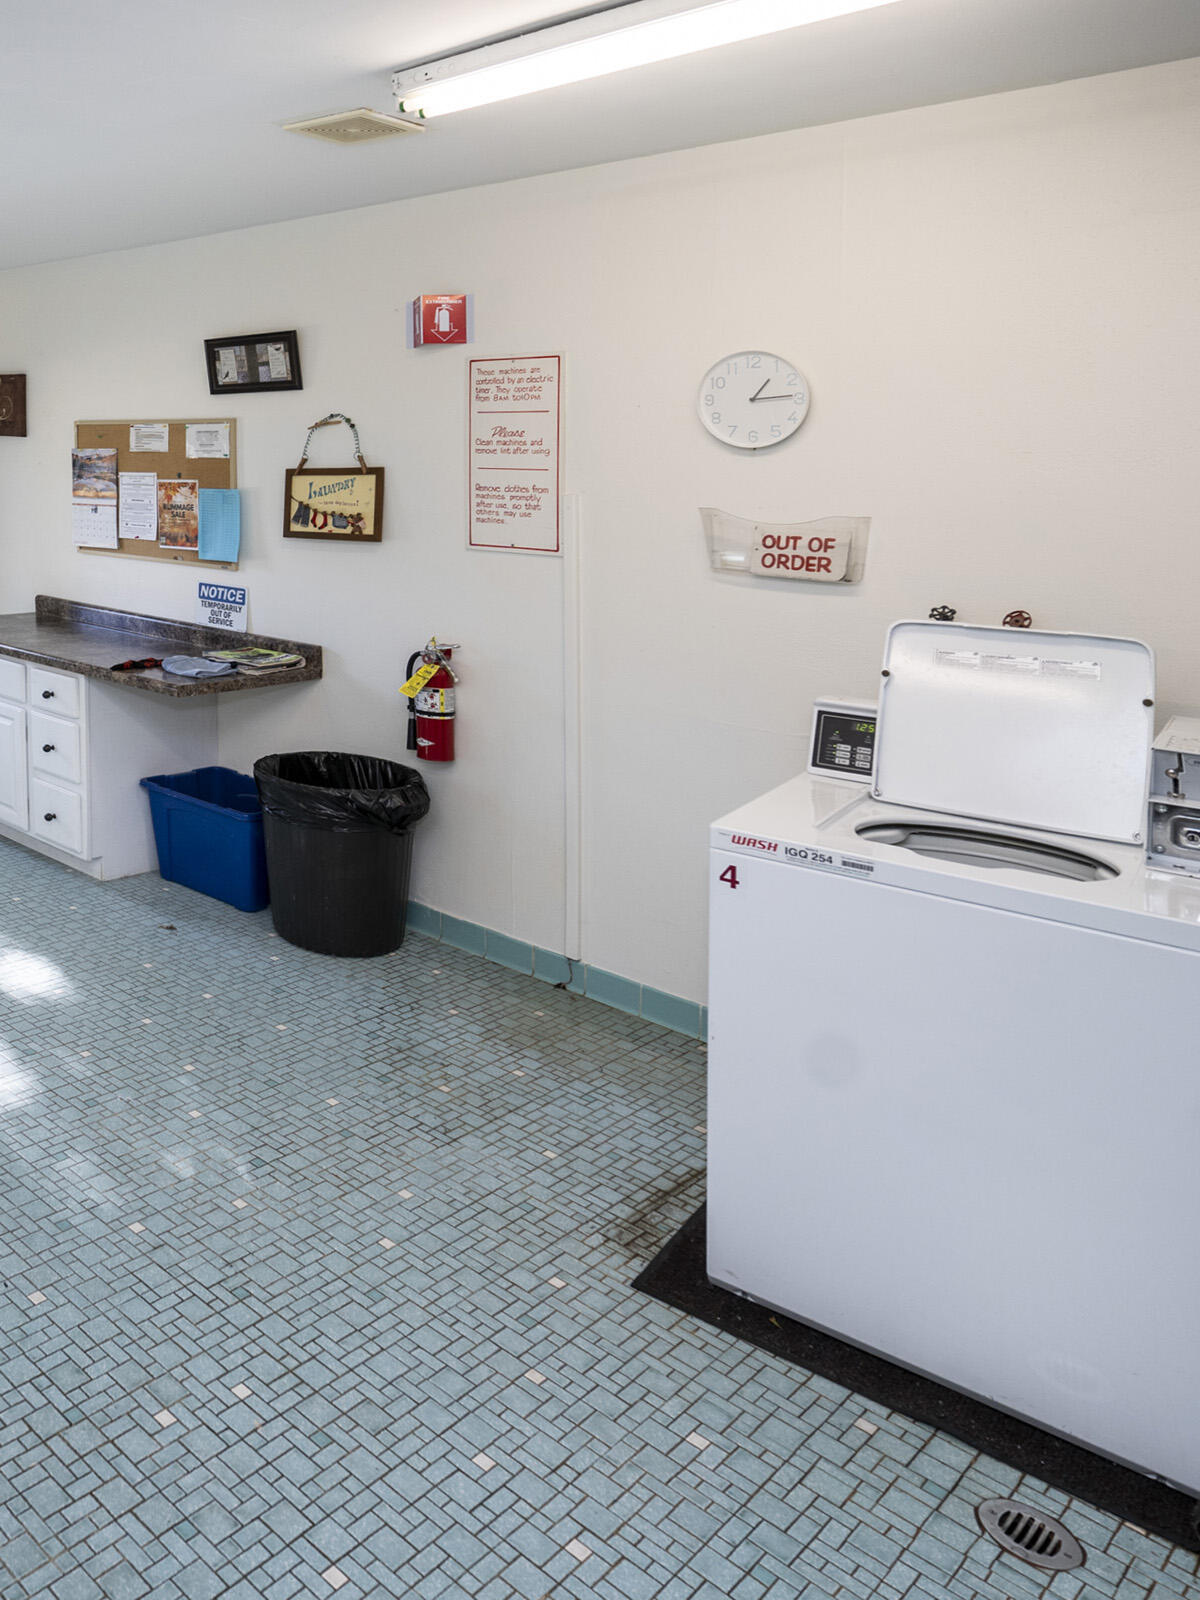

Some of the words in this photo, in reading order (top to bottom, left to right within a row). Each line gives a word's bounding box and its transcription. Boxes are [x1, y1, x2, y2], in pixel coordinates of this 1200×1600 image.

[745, 354, 761, 369] 12
[774, 359, 779, 373] 1
[499, 367, 527, 375] machines
[727, 362, 738, 375] 11
[507, 376, 516, 385] by
[711, 376, 726, 389] 10
[786, 372, 798, 386] 2
[513, 385, 542, 393] operate
[475, 394, 491, 402] from
[704, 394, 715, 407] 9
[793, 391, 806, 405] 3
[711, 411, 721, 425] 8
[787, 411, 799, 424] 4
[491, 425, 526, 438] Please
[727, 425, 738, 438] 7
[748, 430, 759, 443] 6
[770, 424, 782, 438] 5
[475, 438, 493, 446] Clean
[530, 438, 543, 446] and
[512, 447, 529, 455] after
[475, 483, 501, 492] Remove
[504, 484, 530, 493] clothes
[532, 484, 549, 494] from
[475, 500, 494, 508] after
[509, 494, 541, 504] promptly
[171, 510, 186, 518] SALE
[761, 534, 802, 551] OUT
[807, 536, 836, 554] OF
[760, 552, 832, 574] ORDER
[200, 585, 245, 602] NOTICE
[201, 600, 243, 613] TEMPORARILY
[210, 609, 222, 618] OUT
[223, 611, 232, 619] OF
[208, 616, 234, 627] SERVICE
[731, 834, 779, 852] WASH
[784, 846, 809, 859] IGQ
[811, 852, 833, 864] 254
[719, 864, 740, 890] 4
